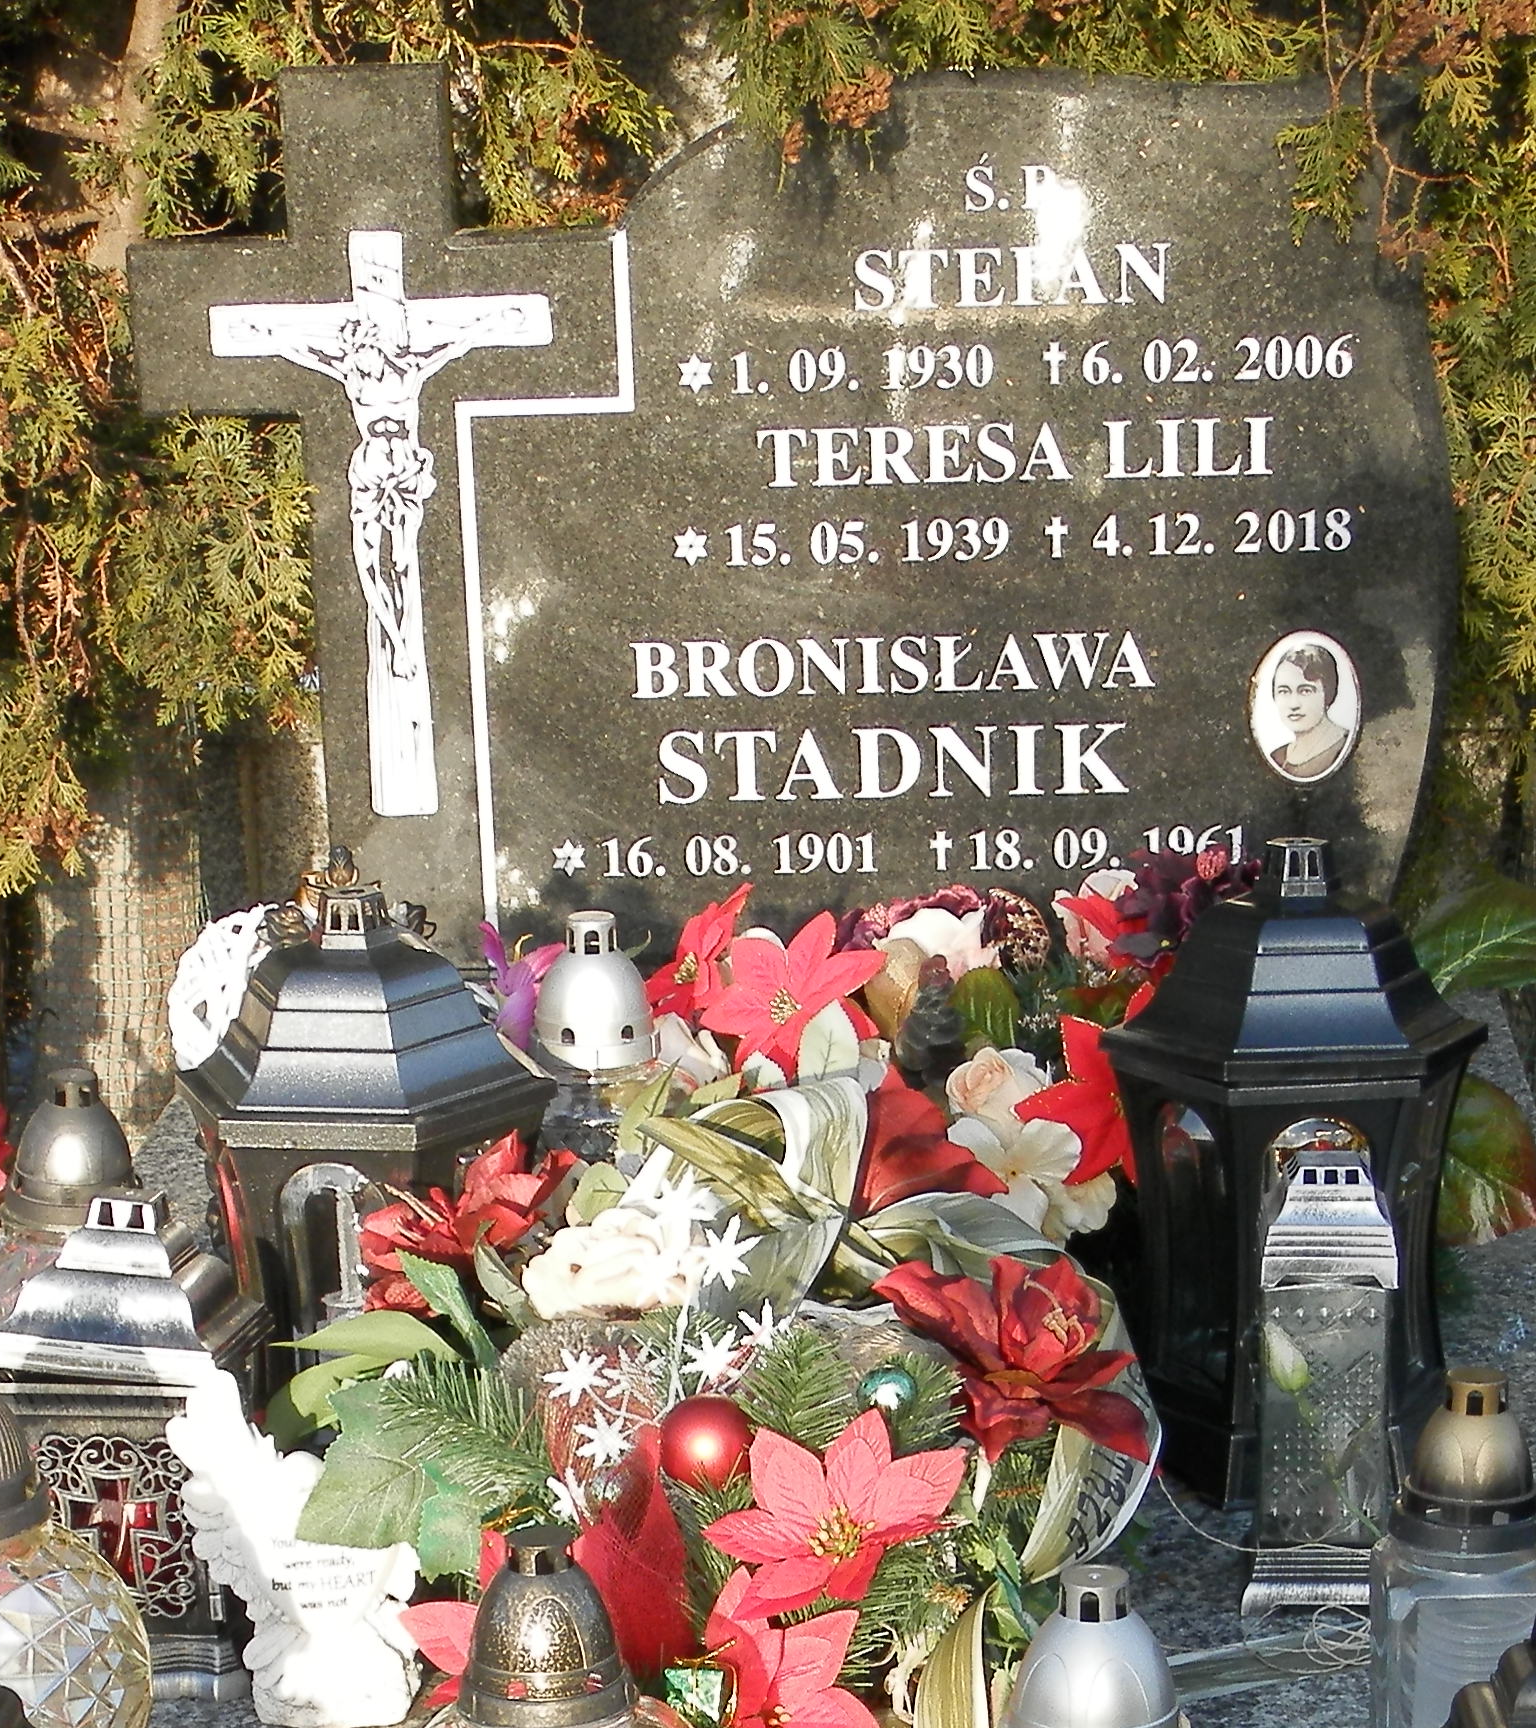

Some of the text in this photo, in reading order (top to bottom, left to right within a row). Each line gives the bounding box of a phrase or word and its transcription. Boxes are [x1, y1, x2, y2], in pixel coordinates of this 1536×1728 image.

[965, 153, 1010, 212] Ś.
[732, 356, 769, 395] 1.
[788, 348, 859, 394] 09.
[880, 342, 994, 391] 1930
[1144, 338, 1212, 383] 02.
[1235, 334, 1355, 380] 2006
[757, 416, 1274, 488] TERESA LILI
[723, 507, 1352, 567] 15. 05. 1939 4. 12. 2018
[630, 631, 1155, 700] BRONISŁAWA
[657, 722, 1130, 803] STADNIK
[602, 836, 665, 878] 16.
[685, 834, 751, 876] 08.
[773, 831, 876, 875] 1901
[968, 829, 1036, 872] 18.
[1053, 826, 1121, 870] 09.
